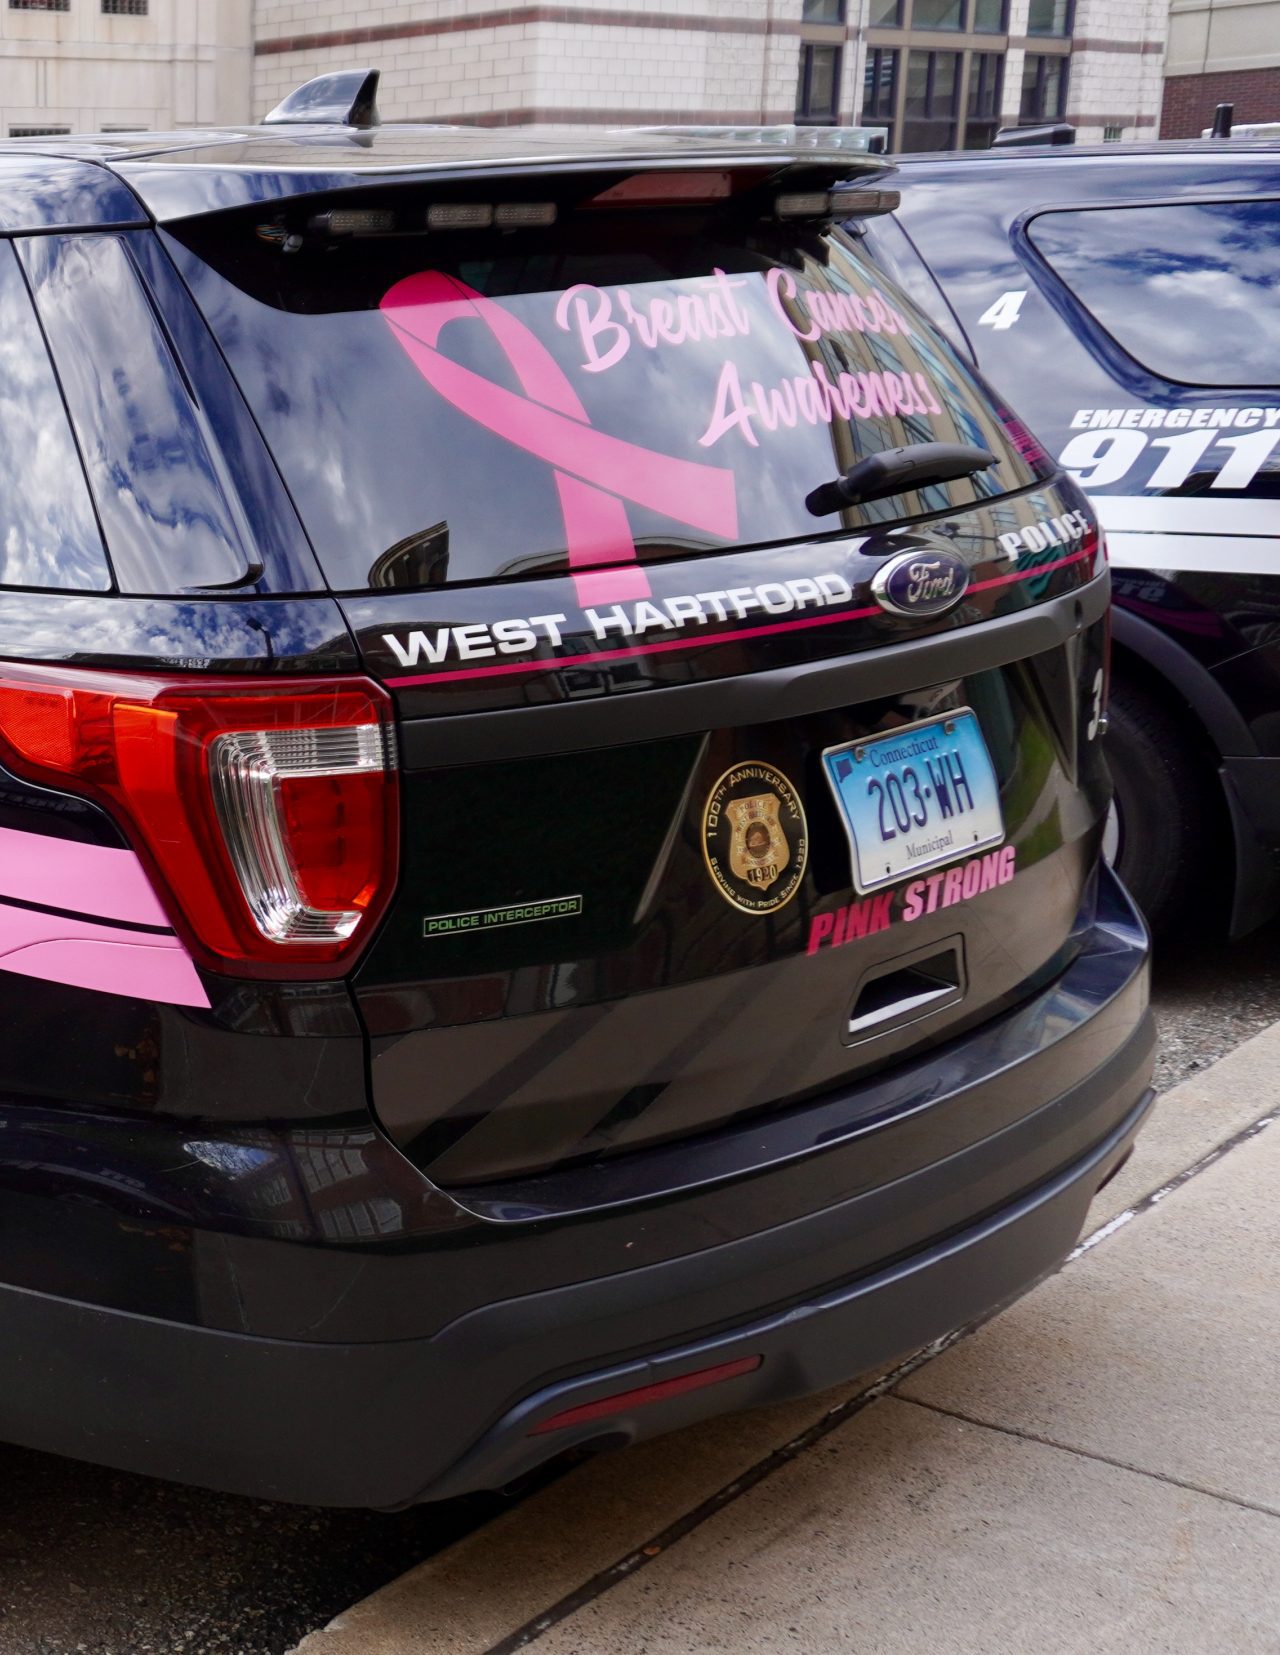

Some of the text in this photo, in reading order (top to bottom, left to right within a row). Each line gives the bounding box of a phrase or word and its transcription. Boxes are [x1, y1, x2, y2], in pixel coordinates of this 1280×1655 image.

[556, 267, 911, 373] Breast Cancer
[977, 290, 1028, 331] 4
[698, 360, 942, 448] Awareness
[1070, 407, 1280, 429] EMERGENCY
[1058, 428, 1280, 489] 911
[998, 508, 1093, 562] POLICE
[907, 560, 956, 603] Ford
[381, 573, 852, 668] WEST HARTFORD
[869, 736, 939, 768] Connecticut
[707, 786, 727, 837] 100TH
[729, 768, 801, 819] ANNIVERSARY
[906, 831, 954, 860] Municipal
[710, 858, 736, 897] SERVING
[737, 894, 756, 908] WITH
[758, 897, 780, 909] PRIDE
[781, 876, 799, 899] SINCE
[748, 864, 778, 883] 1920
[428, 900, 578, 932] POLICE INTERCEPTOR
[804, 845, 1016, 956] PINK STRONG
